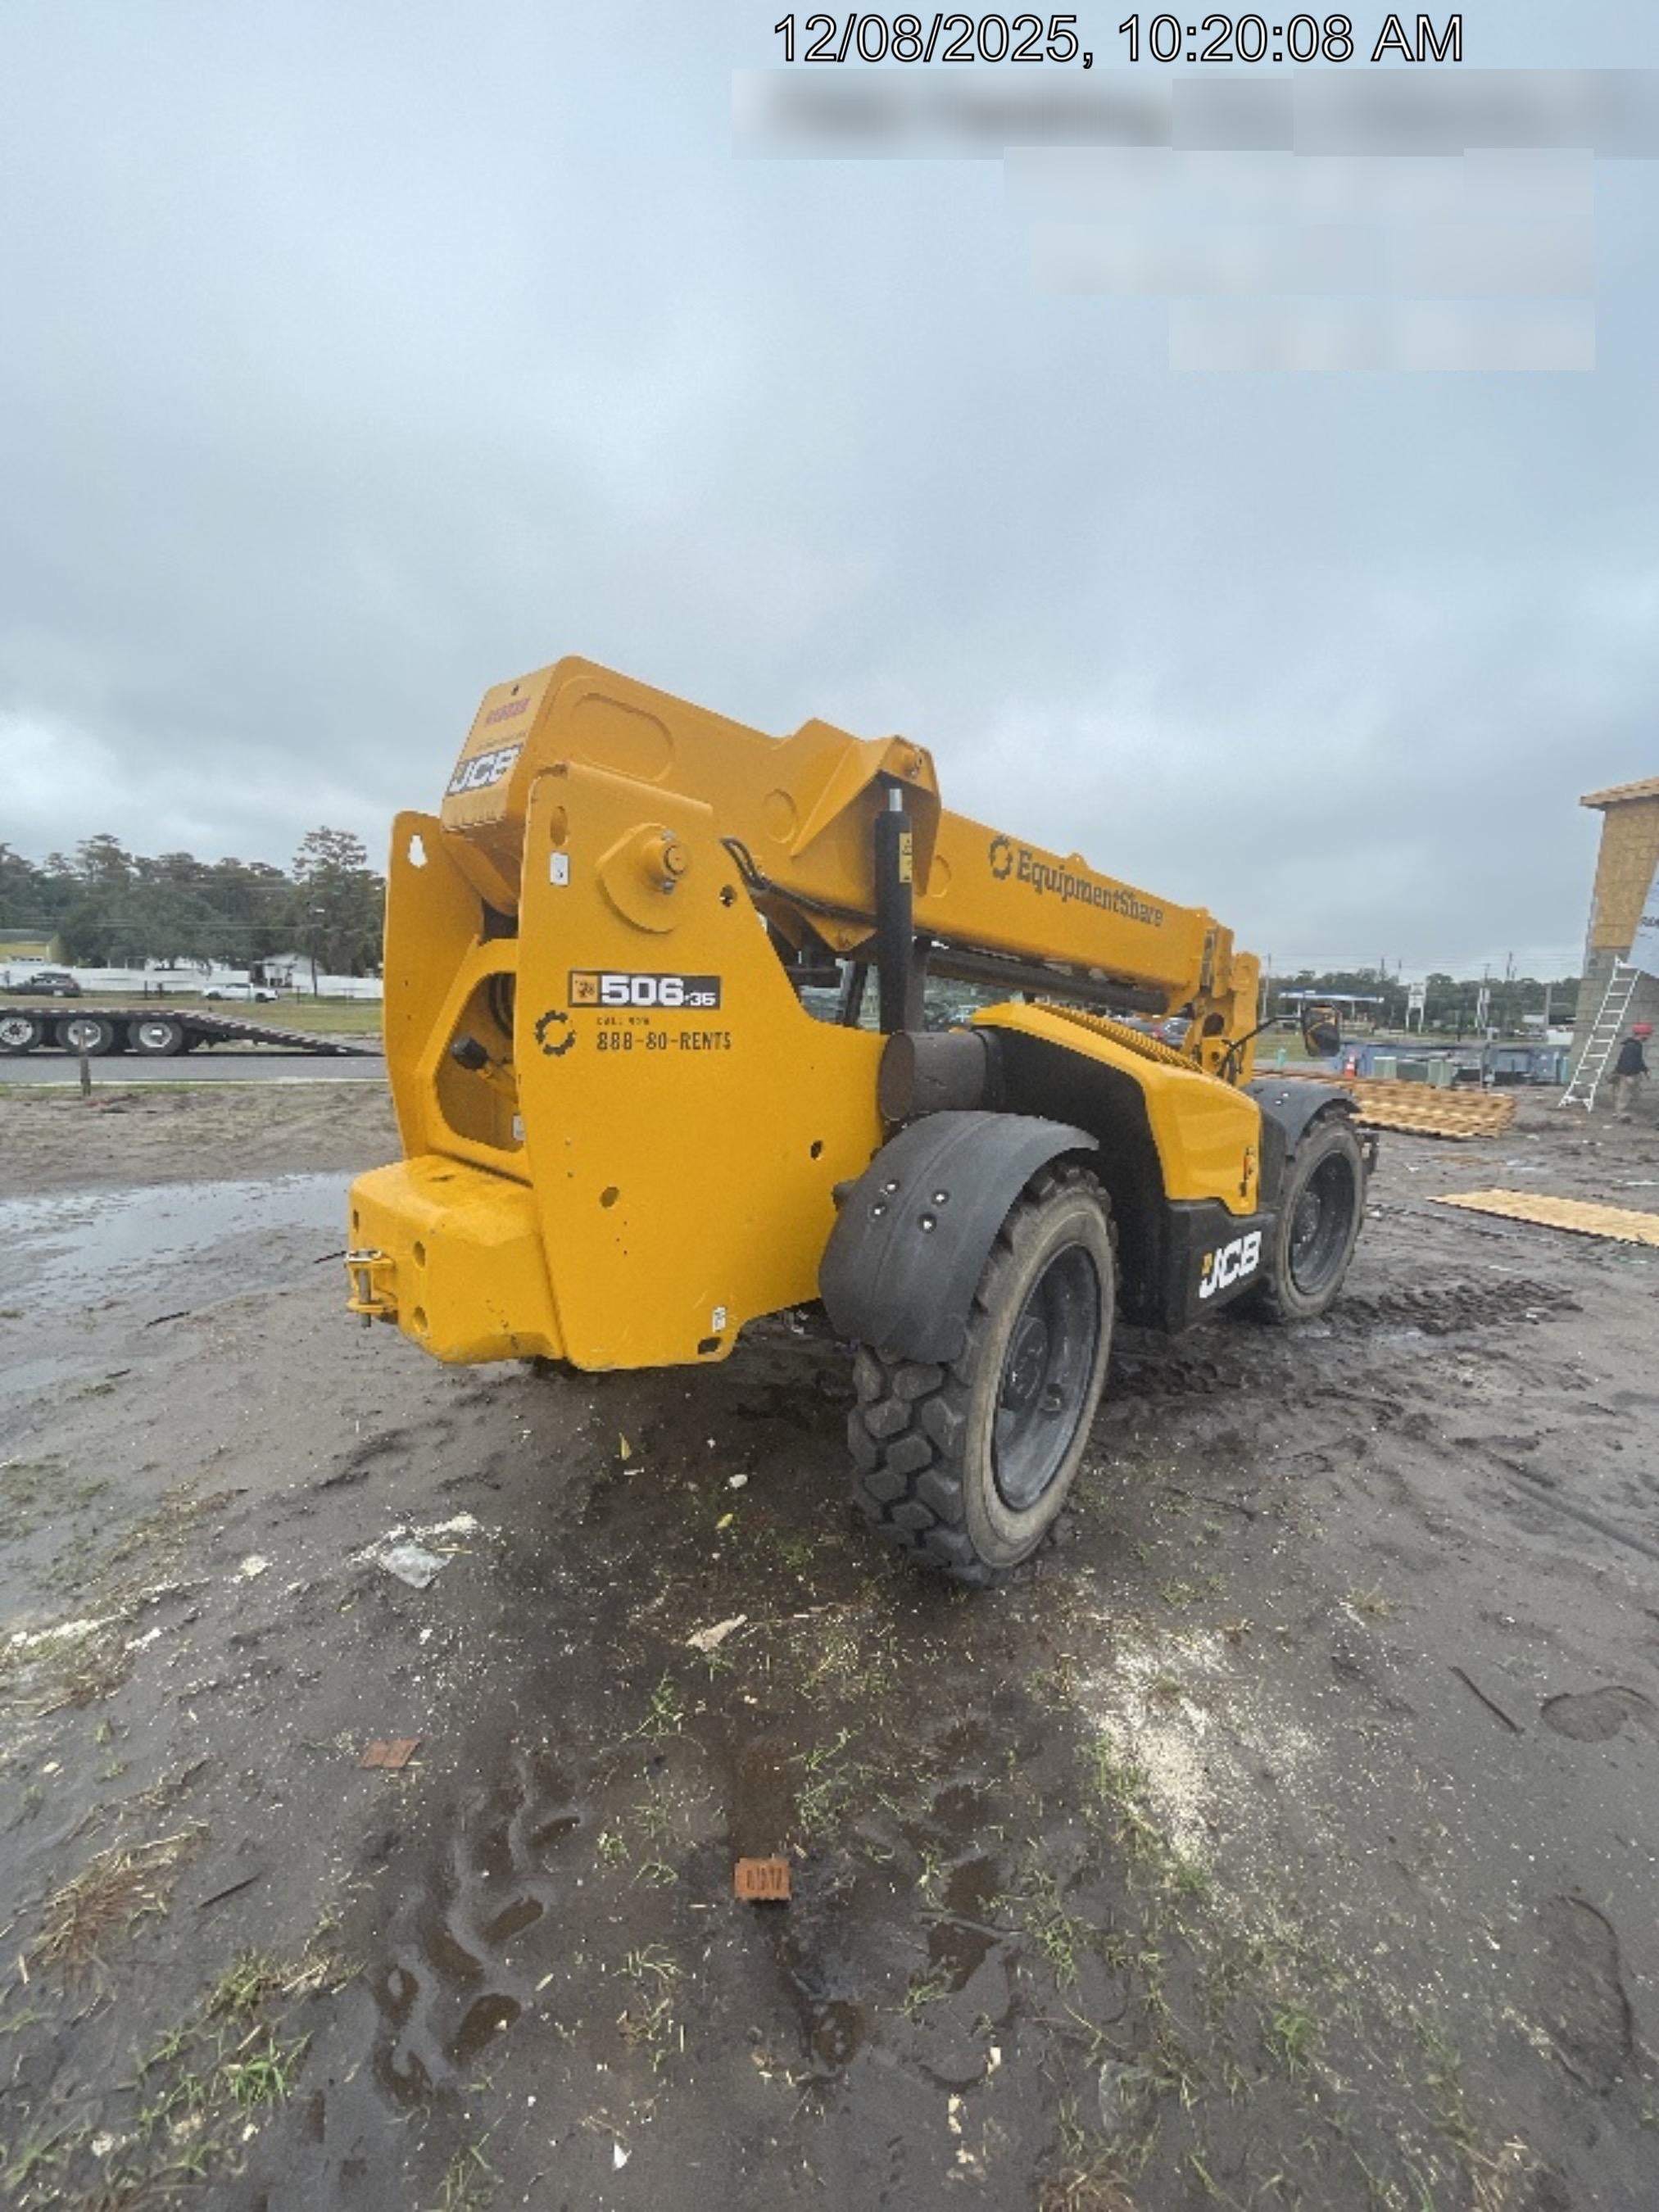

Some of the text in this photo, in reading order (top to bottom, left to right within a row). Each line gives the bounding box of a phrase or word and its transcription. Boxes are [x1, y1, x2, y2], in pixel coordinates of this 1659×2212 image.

[448, 745, 523, 794] JCB
[1017, 849, 1163, 927] EquipmentShare
[596, 1031, 731, 1050] 888-80-RENTS
[1199, 1231, 1262, 1299] JCB
